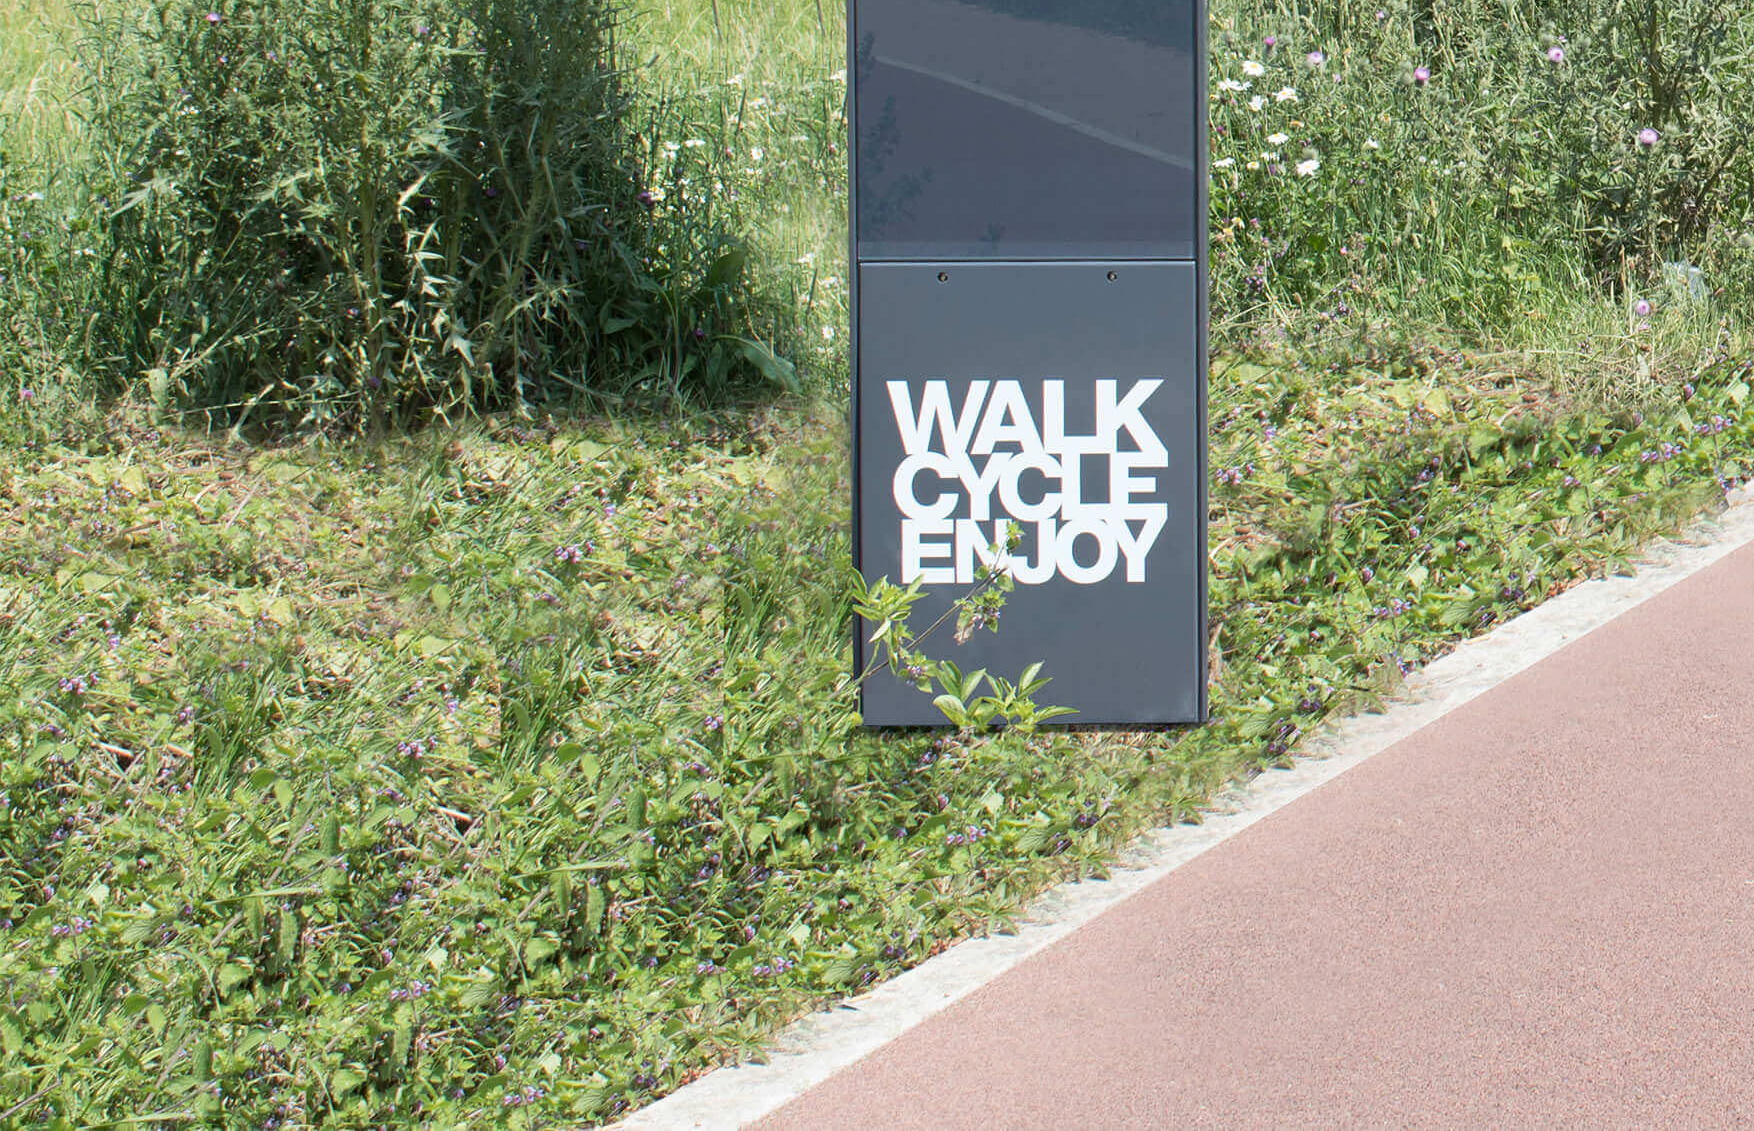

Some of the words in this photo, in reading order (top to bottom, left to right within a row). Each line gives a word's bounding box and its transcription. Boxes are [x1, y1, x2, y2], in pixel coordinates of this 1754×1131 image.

[885, 378, 1169, 454] WALK
[892, 451, 1169, 523] CYCLE
[900, 516, 1169, 584] ENJOY
